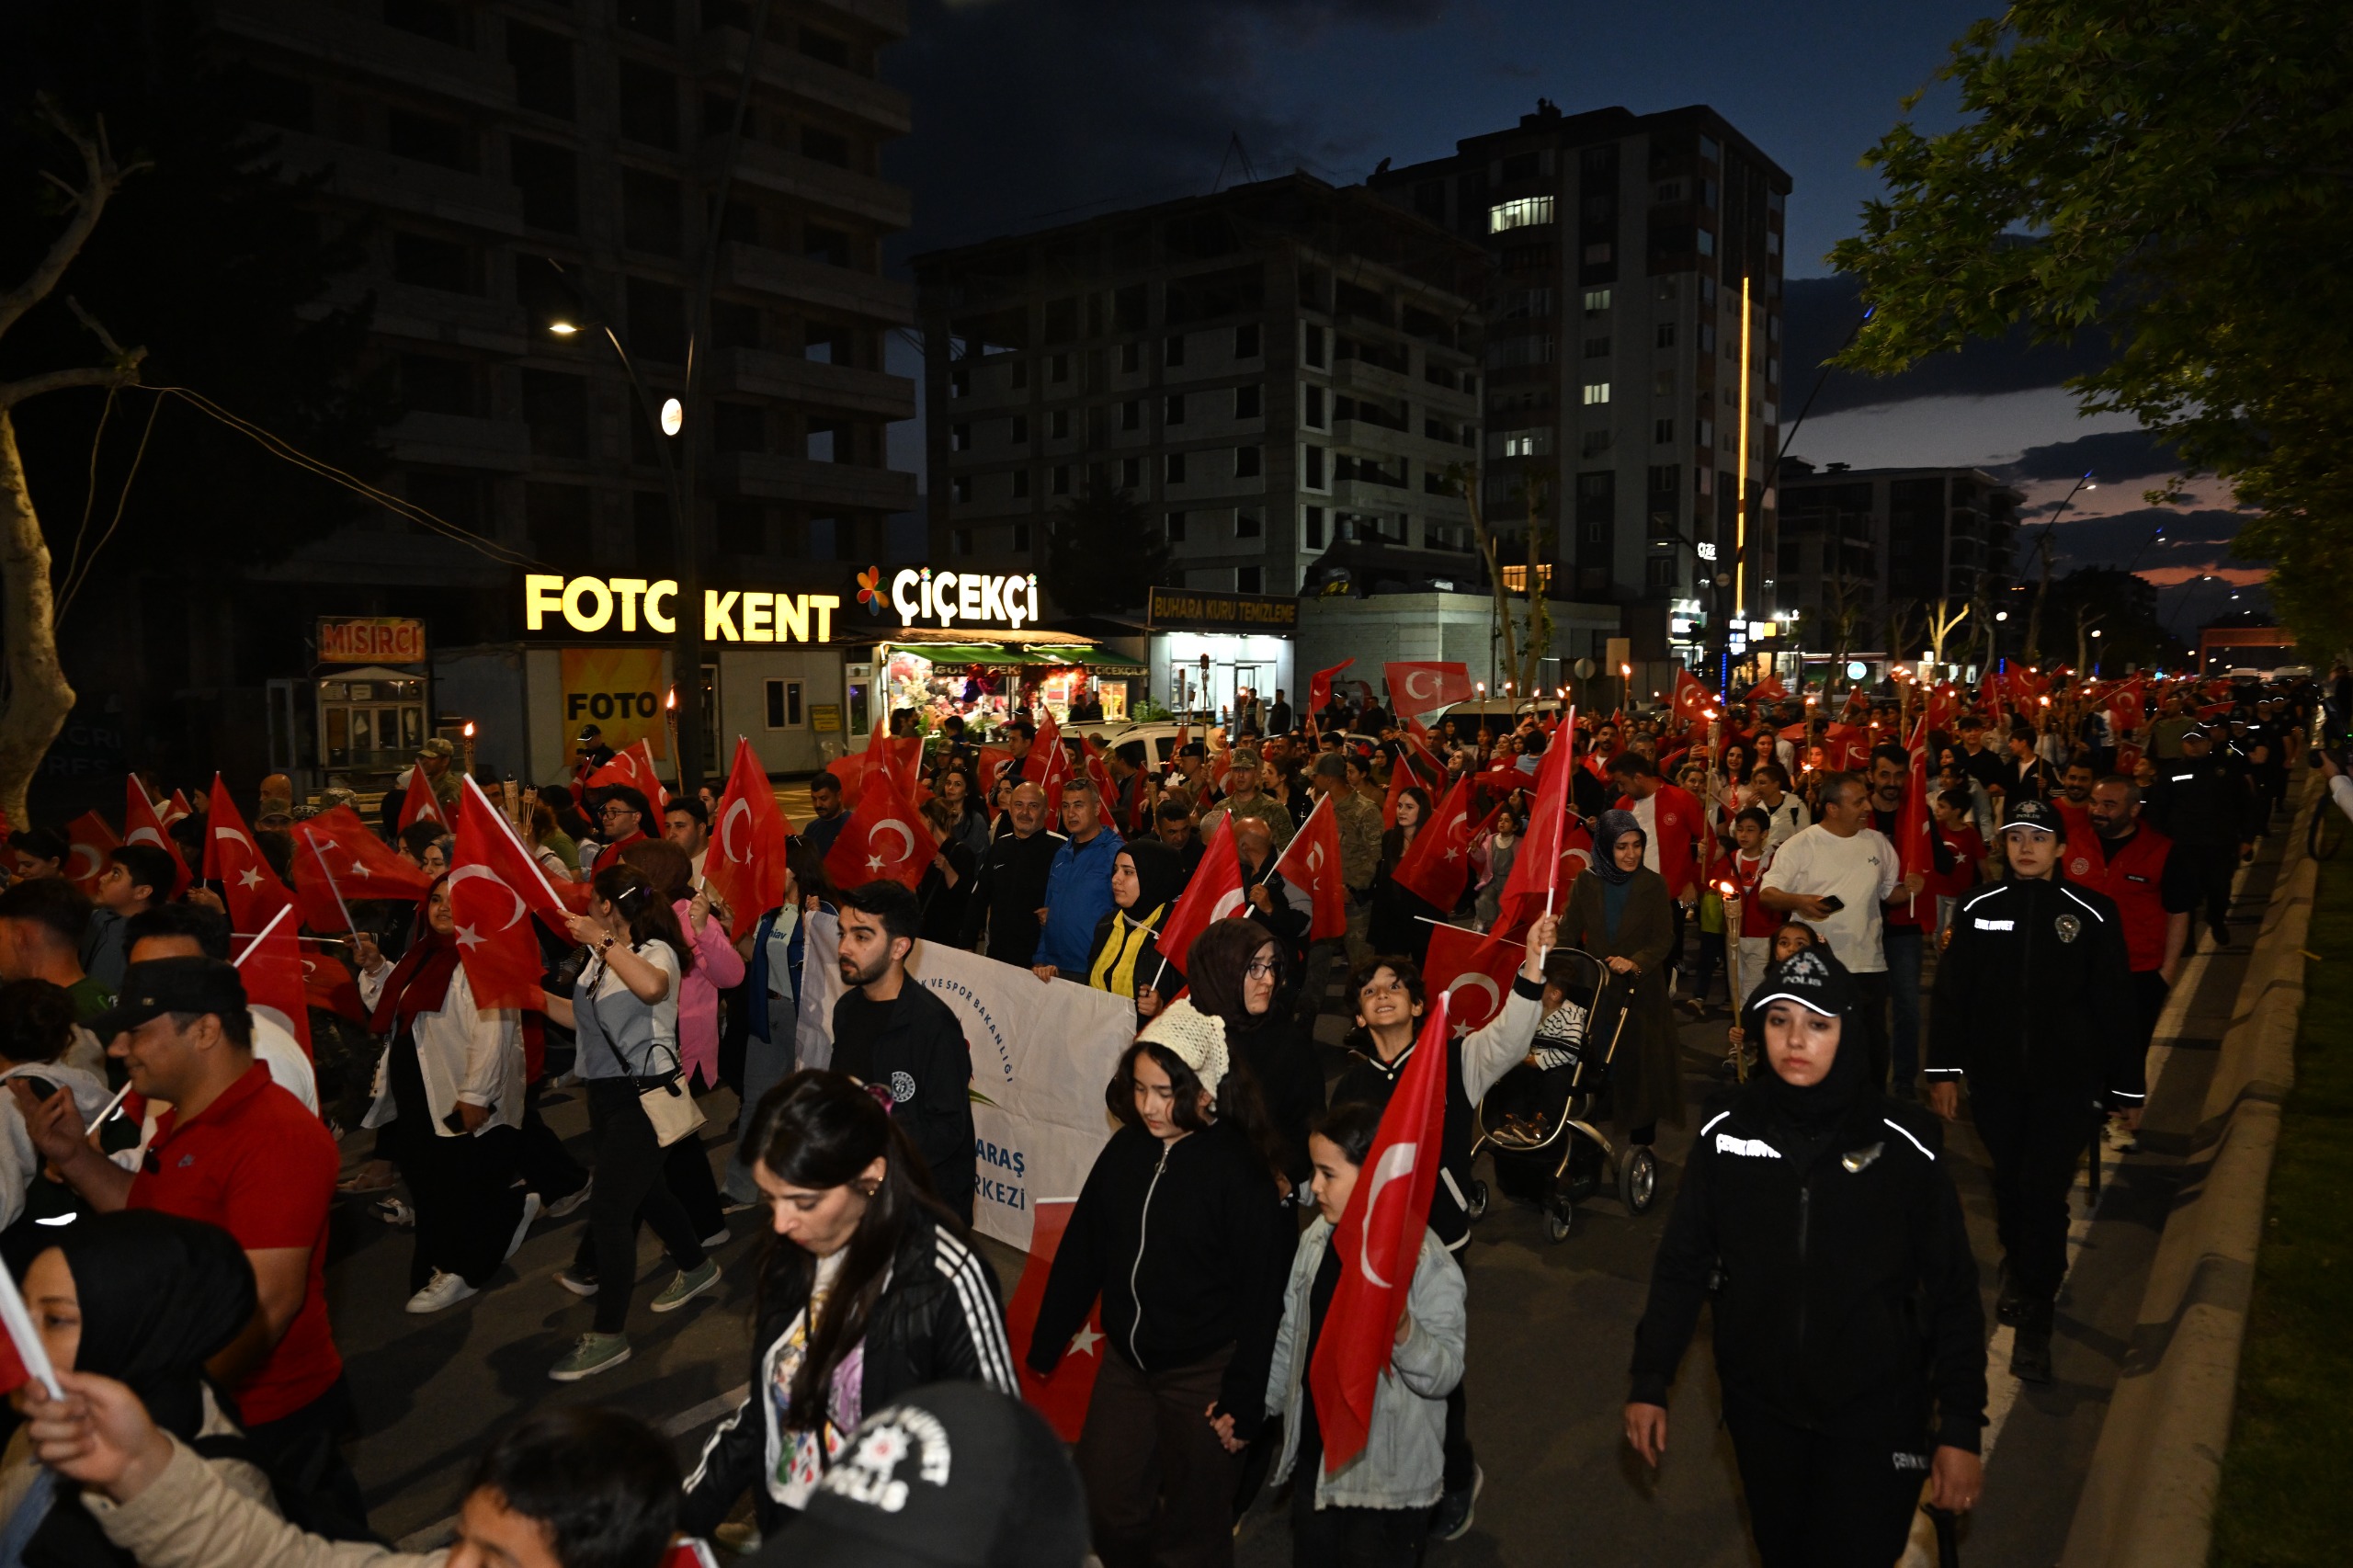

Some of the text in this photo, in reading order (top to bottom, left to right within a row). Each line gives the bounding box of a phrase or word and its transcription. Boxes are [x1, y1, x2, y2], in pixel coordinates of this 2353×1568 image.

[704, 589, 840, 642] KENT
[1154, 597, 1203, 618] BUHARA
[1206, 599, 1236, 620] KURU
[323, 624, 418, 654] MISIRCI
[934, 665, 967, 675] GÜL
[567, 691, 657, 720] FOTO
[931, 978, 1013, 1083] VE SPOR BAKANLIĞI
[975, 1138, 1025, 1178] ARAŞ
[974, 1173, 1025, 1210] RKEZİ
